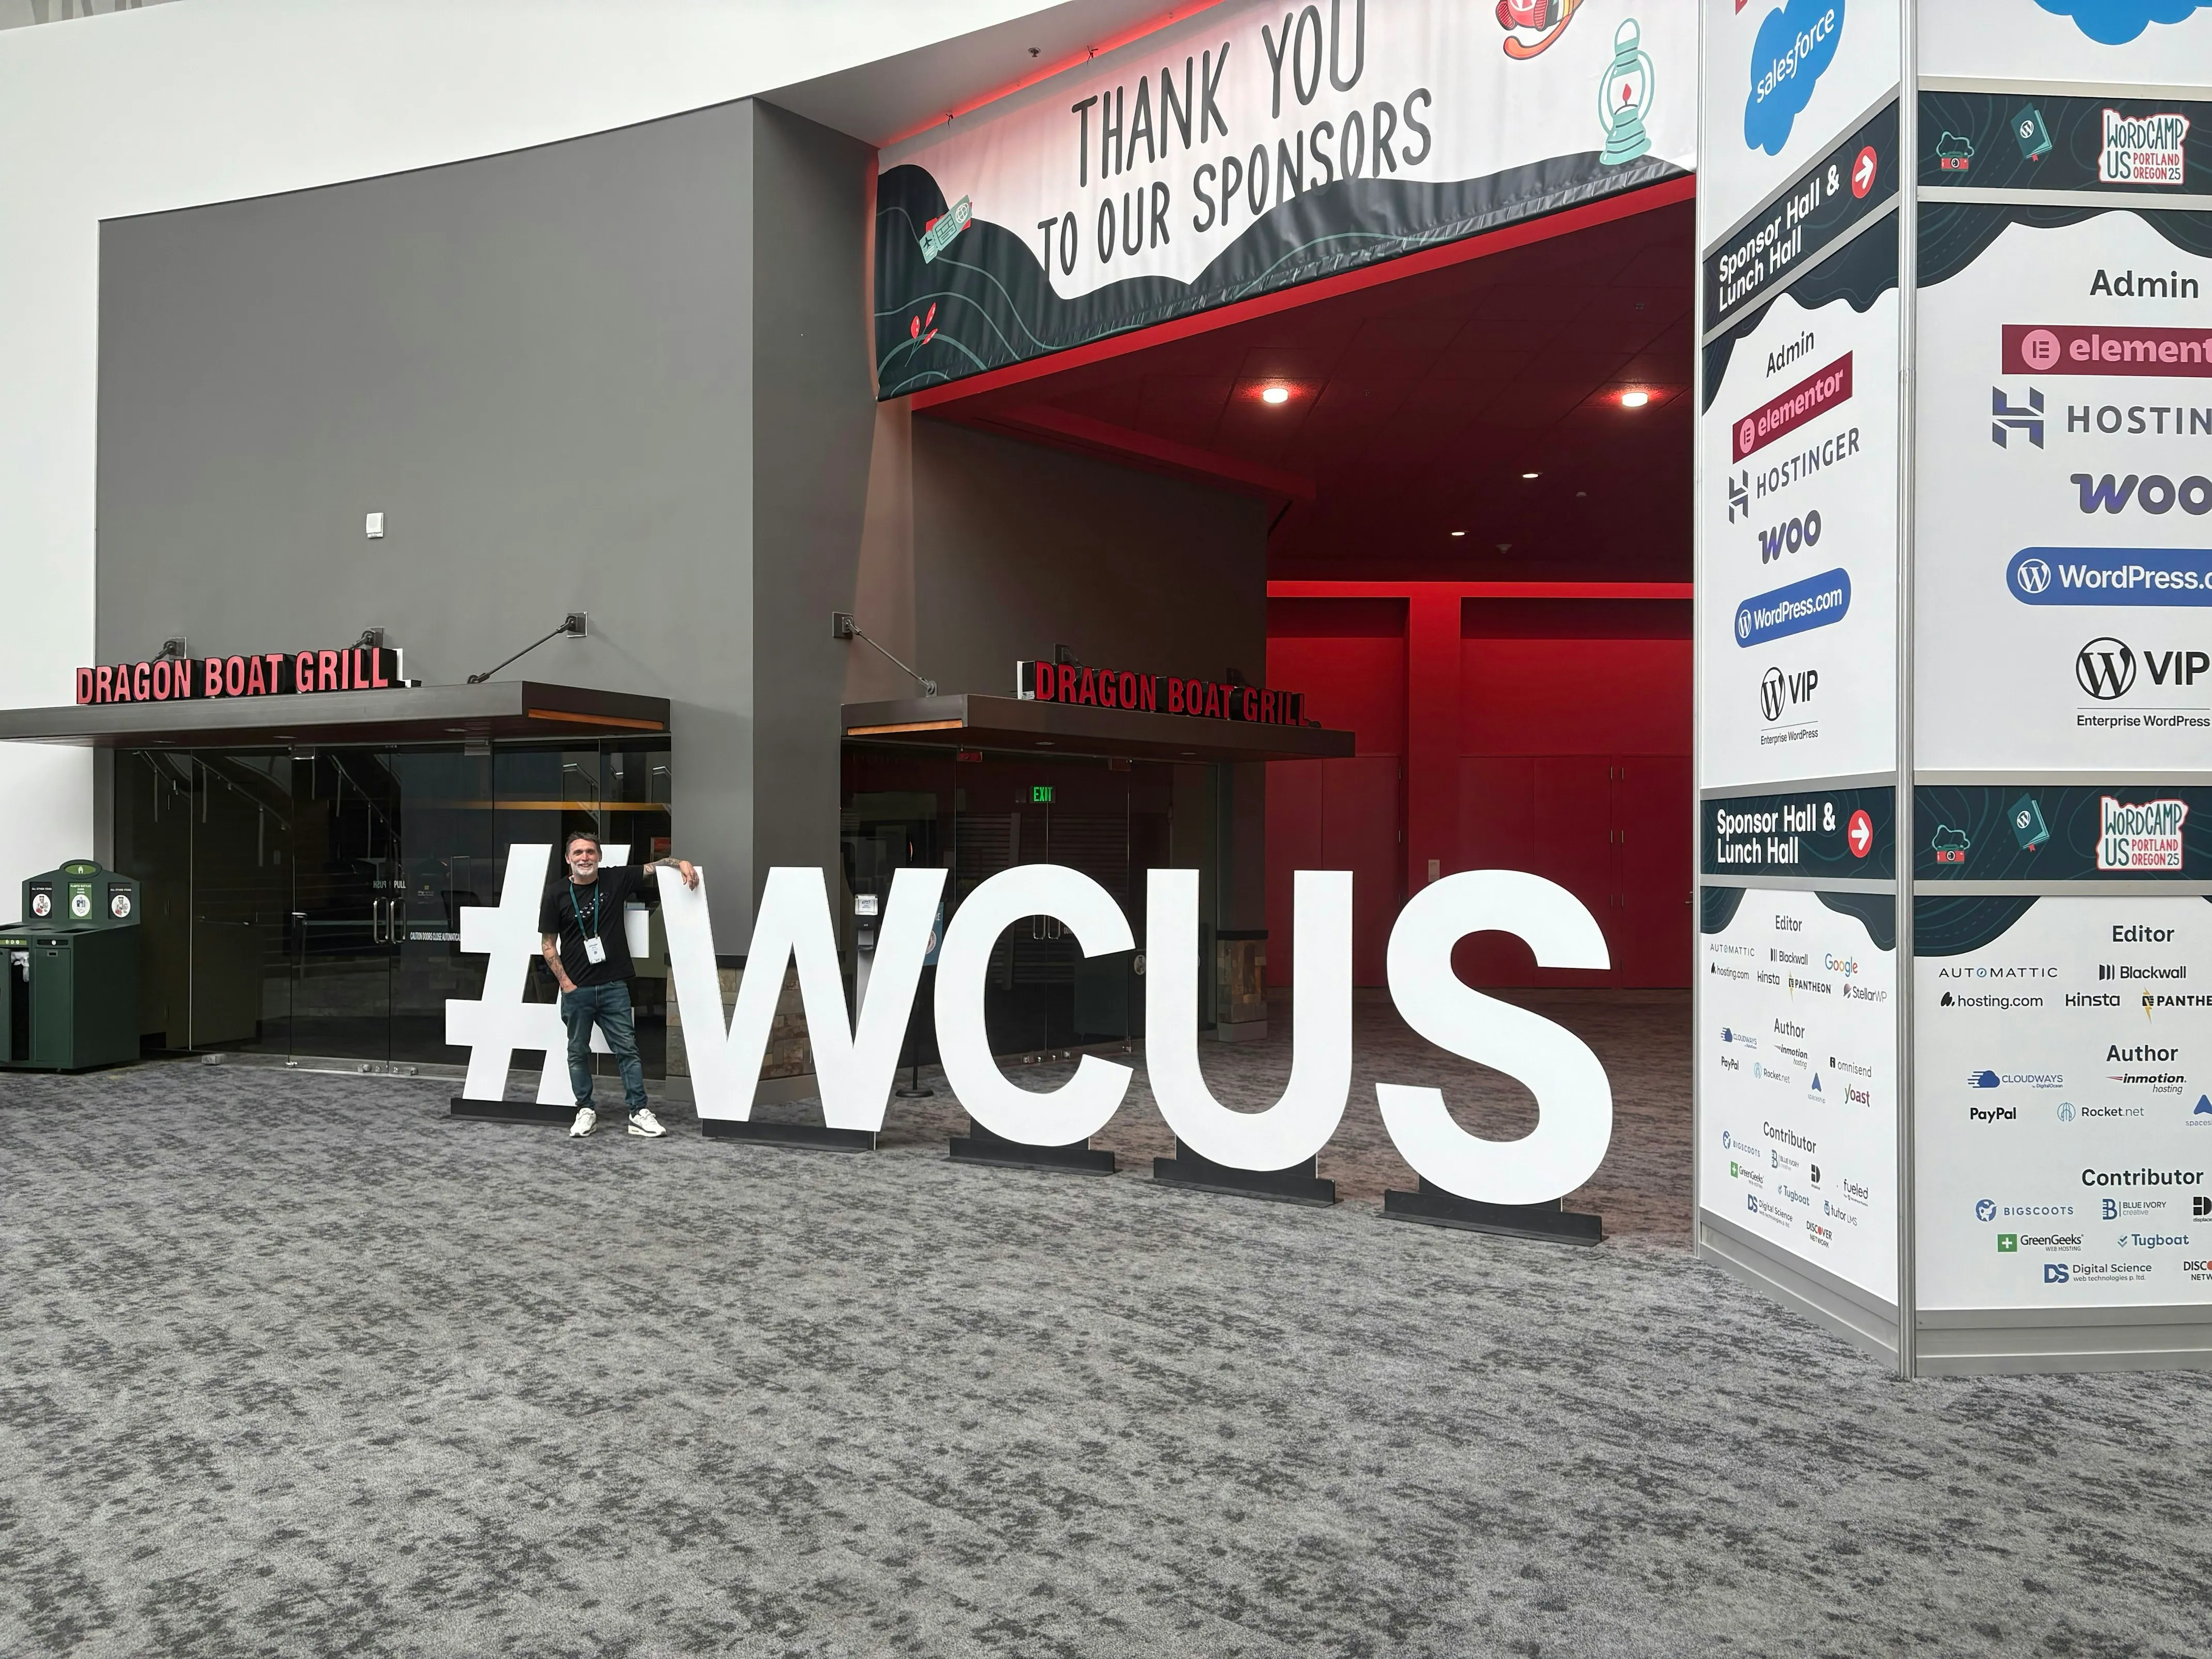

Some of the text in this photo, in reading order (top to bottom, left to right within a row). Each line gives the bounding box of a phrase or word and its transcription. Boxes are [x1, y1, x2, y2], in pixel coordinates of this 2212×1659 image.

[1757, 9, 1835, 103] salesforce
[1071, 0, 1365, 188] THANK YOU
[2107, 114, 2184, 150] WORDCAMP
[2107, 151, 2131, 179] US
[2134, 154, 2179, 166] PORTLAND
[2134, 167, 2182, 180] OREGON 25
[1037, 87, 1432, 278] TO OUR SPONSORS
[1719, 164, 1840, 285] Sponsor Hall &
[1719, 225, 1802, 312] Lunch Hall
[2090, 270, 2199, 298] Admin
[1766, 330, 1814, 378] Admin
[1758, 369, 1844, 437] elementor
[2067, 405, 2212, 435] HOSTIN
[1757, 428, 1860, 499] HOSTINGER
[1754, 588, 1842, 630] WordPress.com
[77, 646, 388, 704] DRAGON BOAT GRILL
[2143, 651, 2210, 685] VIP
[1034, 660, 1310, 726] DRAGON BOAT GRILL
[1789, 670, 1818, 704] VIP
[2077, 715, 2210, 728] Enterprise WordPress
[1761, 729, 1819, 746] Enterprise WordPress
[1034, 786, 1053, 801] EXIT
[1717, 802, 1836, 841] Sponsor Hall &
[2105, 802, 2183, 836] WORDCAMP
[1717, 836, 1799, 864] Lunch Hall
[2106, 838, 2129, 866] US
[2132, 839, 2178, 852] PORTLAND
[2132, 853, 2180, 866] OREGON 25
[394, 880, 406, 889] PULL
[1775, 915, 1803, 931] Editor
[2113, 925, 2175, 943] Editor
[1710, 943, 1755, 956] AUTOMATTIC
[1779, 951, 1808, 966] Blackwall
[1825, 953, 1858, 977] Google
[1717, 967, 1749, 980] hosting.com
[1939, 967, 2058, 978] AUTOMATTIC
[2120, 966, 2187, 979] Blackwall
[1795, 981, 1831, 994] PANTHEON
[1853, 986, 1887, 1003] StellarWP
[1958, 994, 2043, 1009] hosting.com
[1774, 1018, 1805, 1038] Author
[1733, 1033, 1757, 1045] CLOUDWAYS
[2107, 1045, 2178, 1062] Author
[1721, 1056, 1739, 1071] PayPal
[1793, 1058, 1807, 1069] hosting
[1838, 1062, 1872, 1078] omnisend
[1763, 1068, 1790, 1084] Rocket.net
[2002, 1075, 2063, 1083] CLOUDWAYS
[1844, 1083, 1870, 1107] yoast
[2153, 1085, 2183, 1095] hosting
[1970, 1107, 2016, 1124] PayPal
[2082, 1107, 2144, 1117] Rocket.net
[1763, 1121, 1817, 1154] Contributor
[1733, 1141, 1760, 1157] BIGSCOOTS
[2082, 1168, 2204, 1186] Contributor
[1783, 1185, 1810, 1206] Tugboat
[1844, 1179, 1868, 1199] fueled
[1759, 1199, 1774, 1213] Digital
[1775, 1207, 1793, 1222] Science
[1831, 1205, 1846, 1221] tutor
[2004, 1207, 2074, 1216] BIGSCOOTS
[1810, 1234, 1829, 1248] NETWORK
[2020, 1235, 2082, 1245] GreenGeeks
[2131, 1234, 2189, 1249] Tugboat
[2073, 1264, 2108, 1274] Digital
[2110, 1264, 2152, 1273] Science
